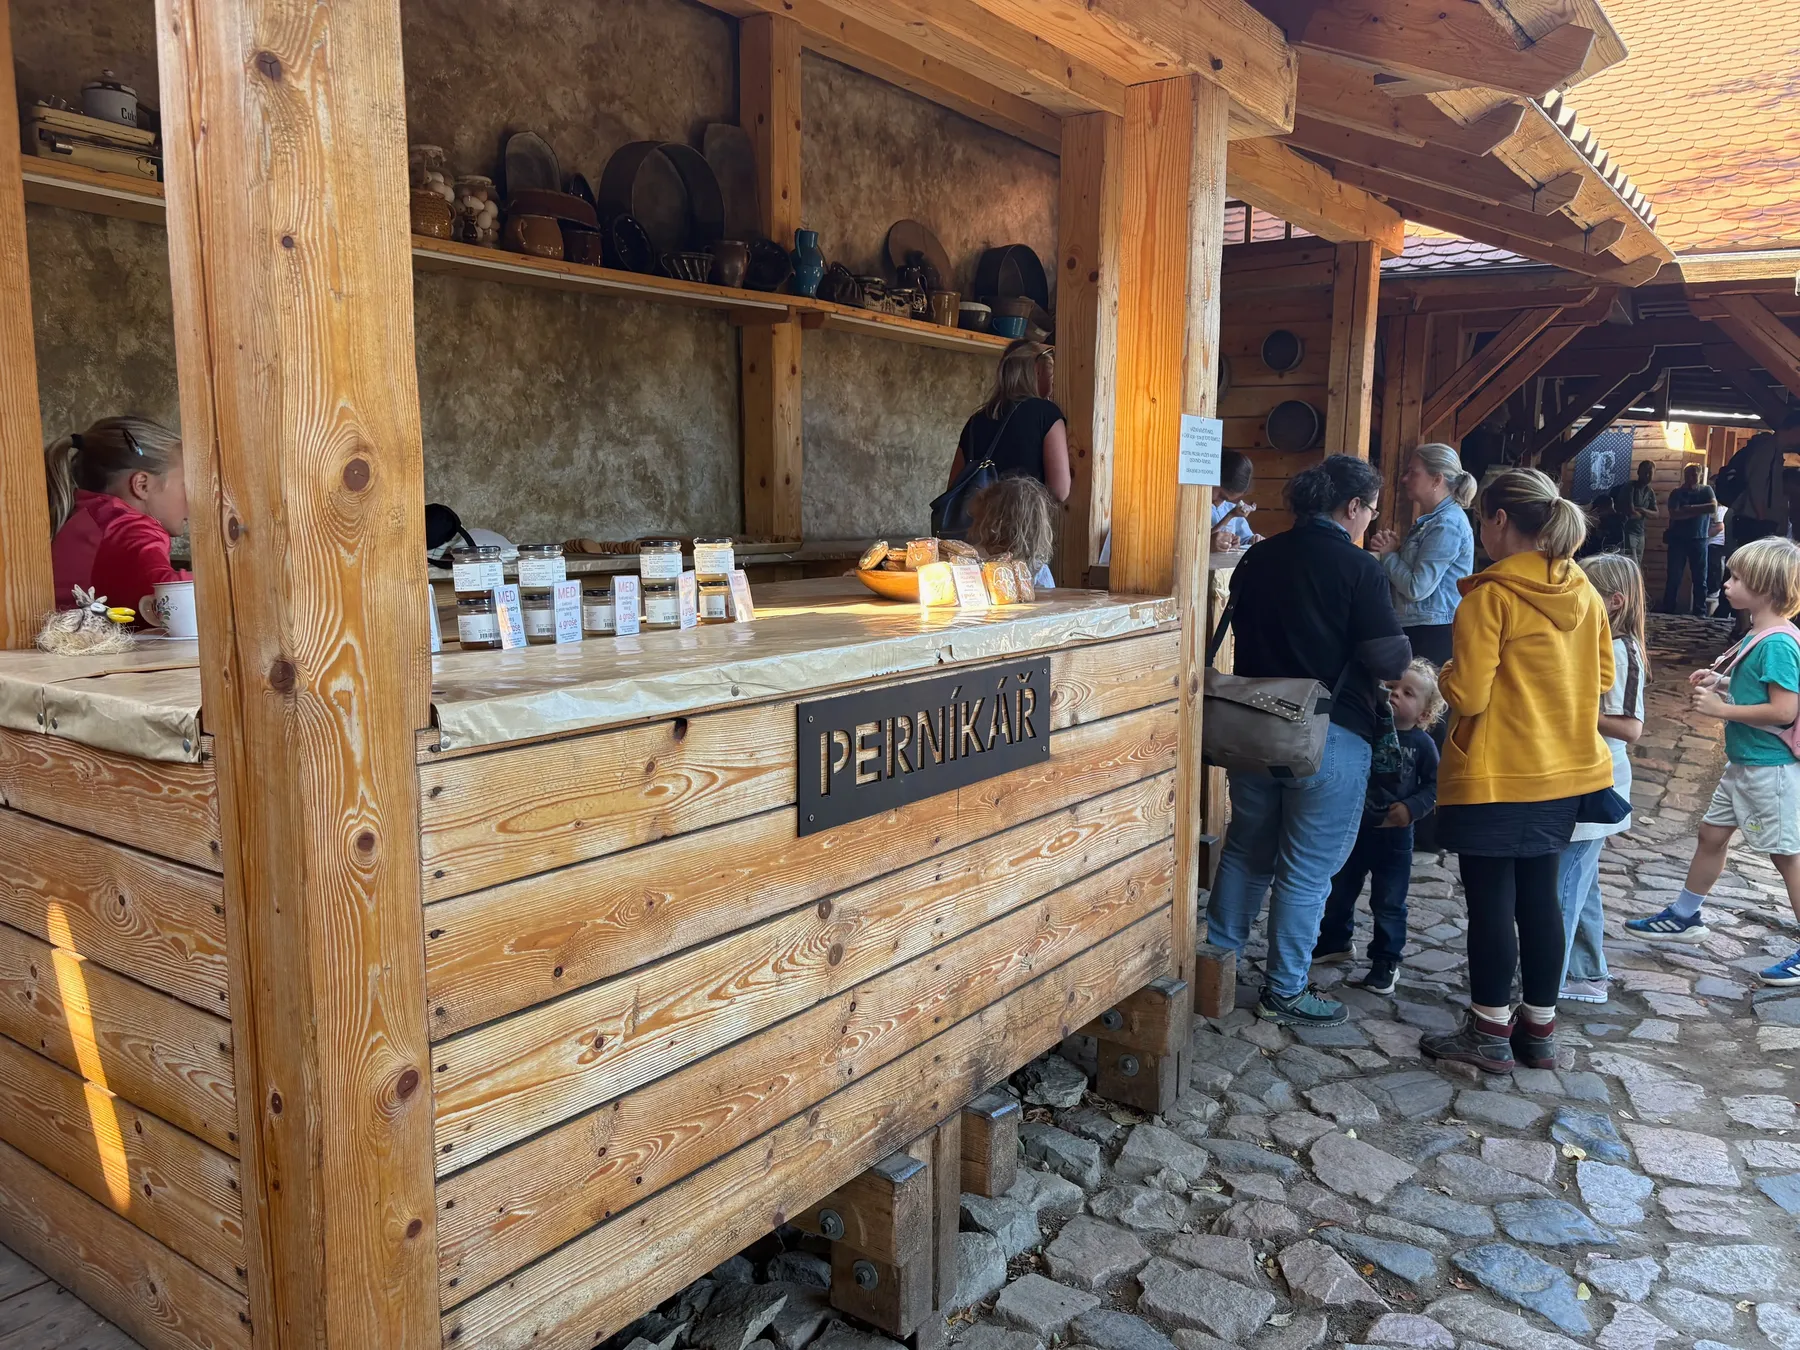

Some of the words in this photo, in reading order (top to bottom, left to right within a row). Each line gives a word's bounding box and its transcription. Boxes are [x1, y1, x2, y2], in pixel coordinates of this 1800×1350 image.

[558, 586, 576, 600] MED
[618, 581, 635, 593] MED
[498, 590, 516, 604] MED
[558, 621, 563, 630] 4
[563, 617, 578, 630] groše
[622, 611, 636, 623] groše
[820, 671, 1038, 797] PERNÍKÁŘ
